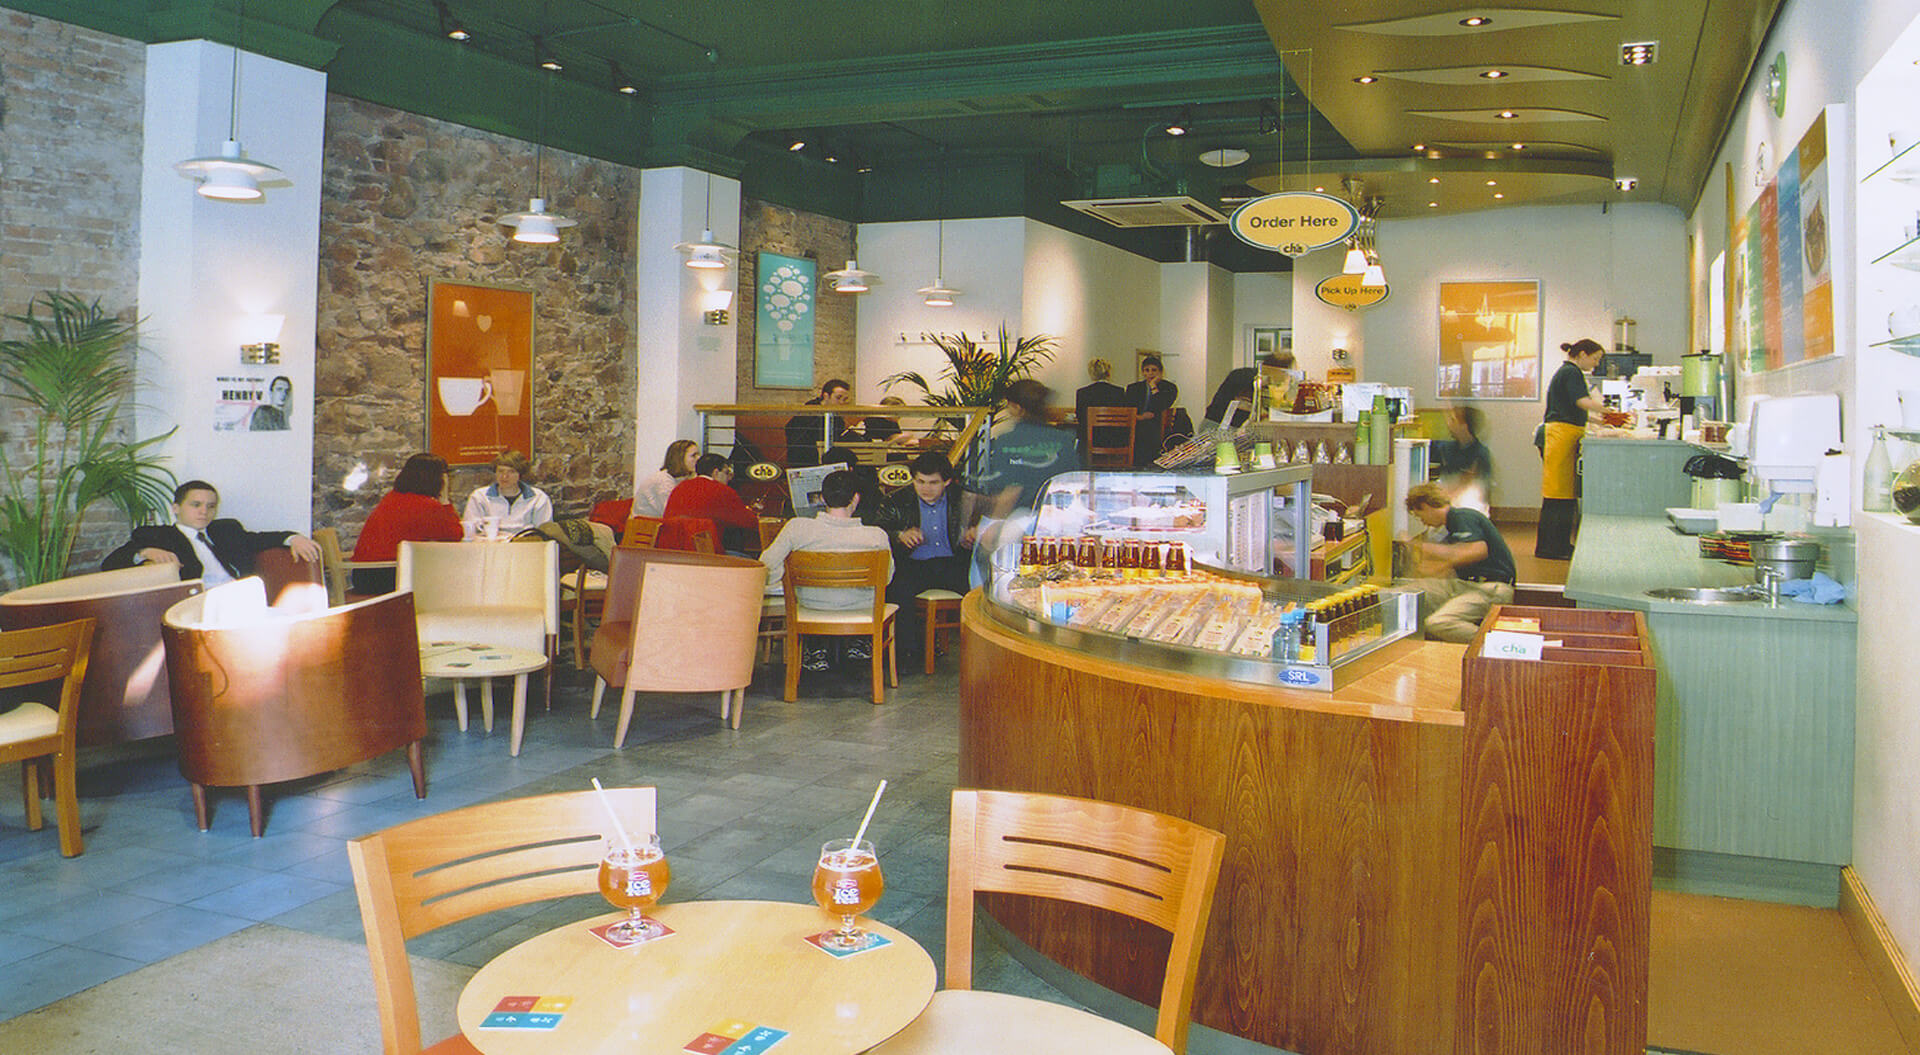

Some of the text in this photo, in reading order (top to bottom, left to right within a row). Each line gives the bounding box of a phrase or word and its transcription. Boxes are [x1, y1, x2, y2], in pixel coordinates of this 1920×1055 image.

[1249, 215, 1339, 229] Order Here
[1321, 287, 1383, 296] Pick Up Here
[222, 390, 263, 400] HENRY V
[1287, 670, 1310, 682] SRL
